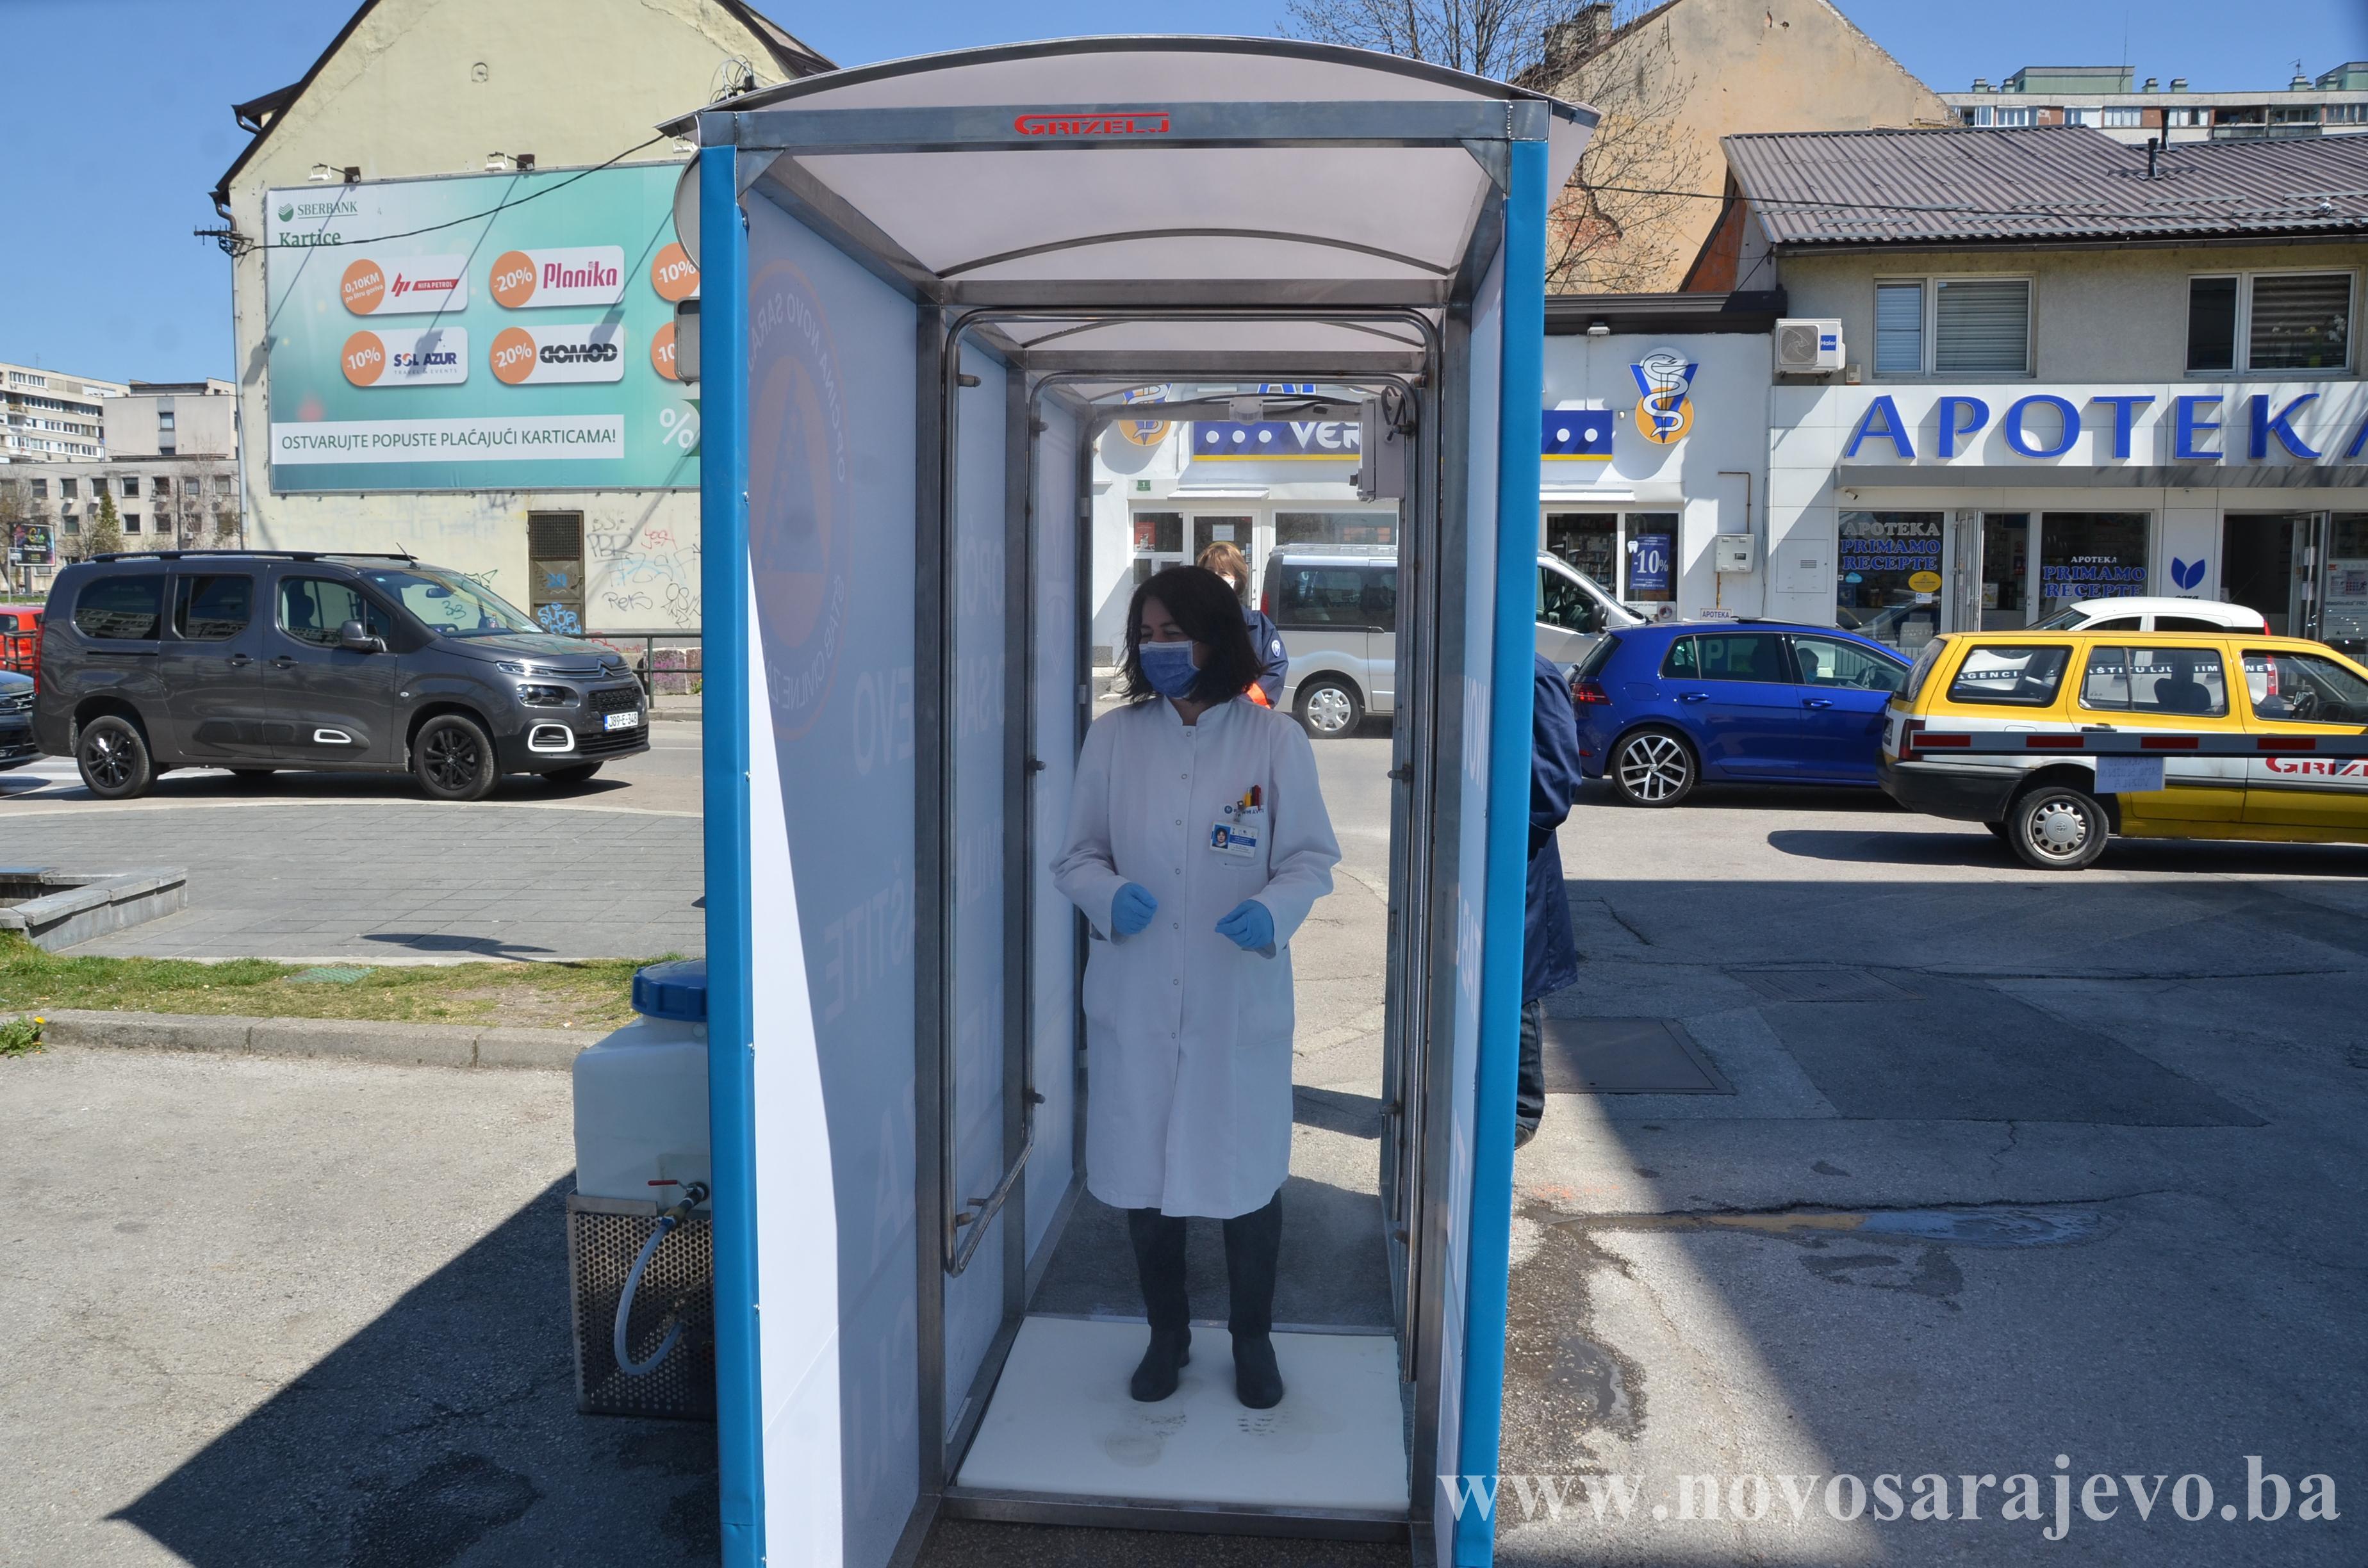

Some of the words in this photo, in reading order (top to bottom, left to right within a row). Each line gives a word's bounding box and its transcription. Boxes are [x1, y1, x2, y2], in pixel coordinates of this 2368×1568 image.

[297, 201, 358, 216] SBERBANK
[279, 229, 341, 246] Kartice
[494, 266, 533, 293] -20%
[543, 261, 618, 289] Planika
[347, 347, 381, 370] -10%
[393, 353, 419, 367] SOL
[423, 352, 457, 365] AZUR
[494, 342, 532, 368] -20%
[657, 343, 675, 363] -10
[282, 434, 368, 450] OSTVARUJTE
[372, 432, 436, 446] POPUSTE
[441, 427, 517, 447] PLAĆAJUĆI
[522, 429, 616, 443] KARTICAMA!
[1842, 522, 1941, 536] APOTEKA
[1840, 539, 1941, 554] PRIMAMO
[1634, 550, 1668, 573] -10%
[1842, 555, 1937, 571] RECEPTE
[2043, 566, 2146, 582] PRIMAMO
[2044, 583, 2143, 598] RECEPTE
[1958, 671, 2018, 680] AGENCI
